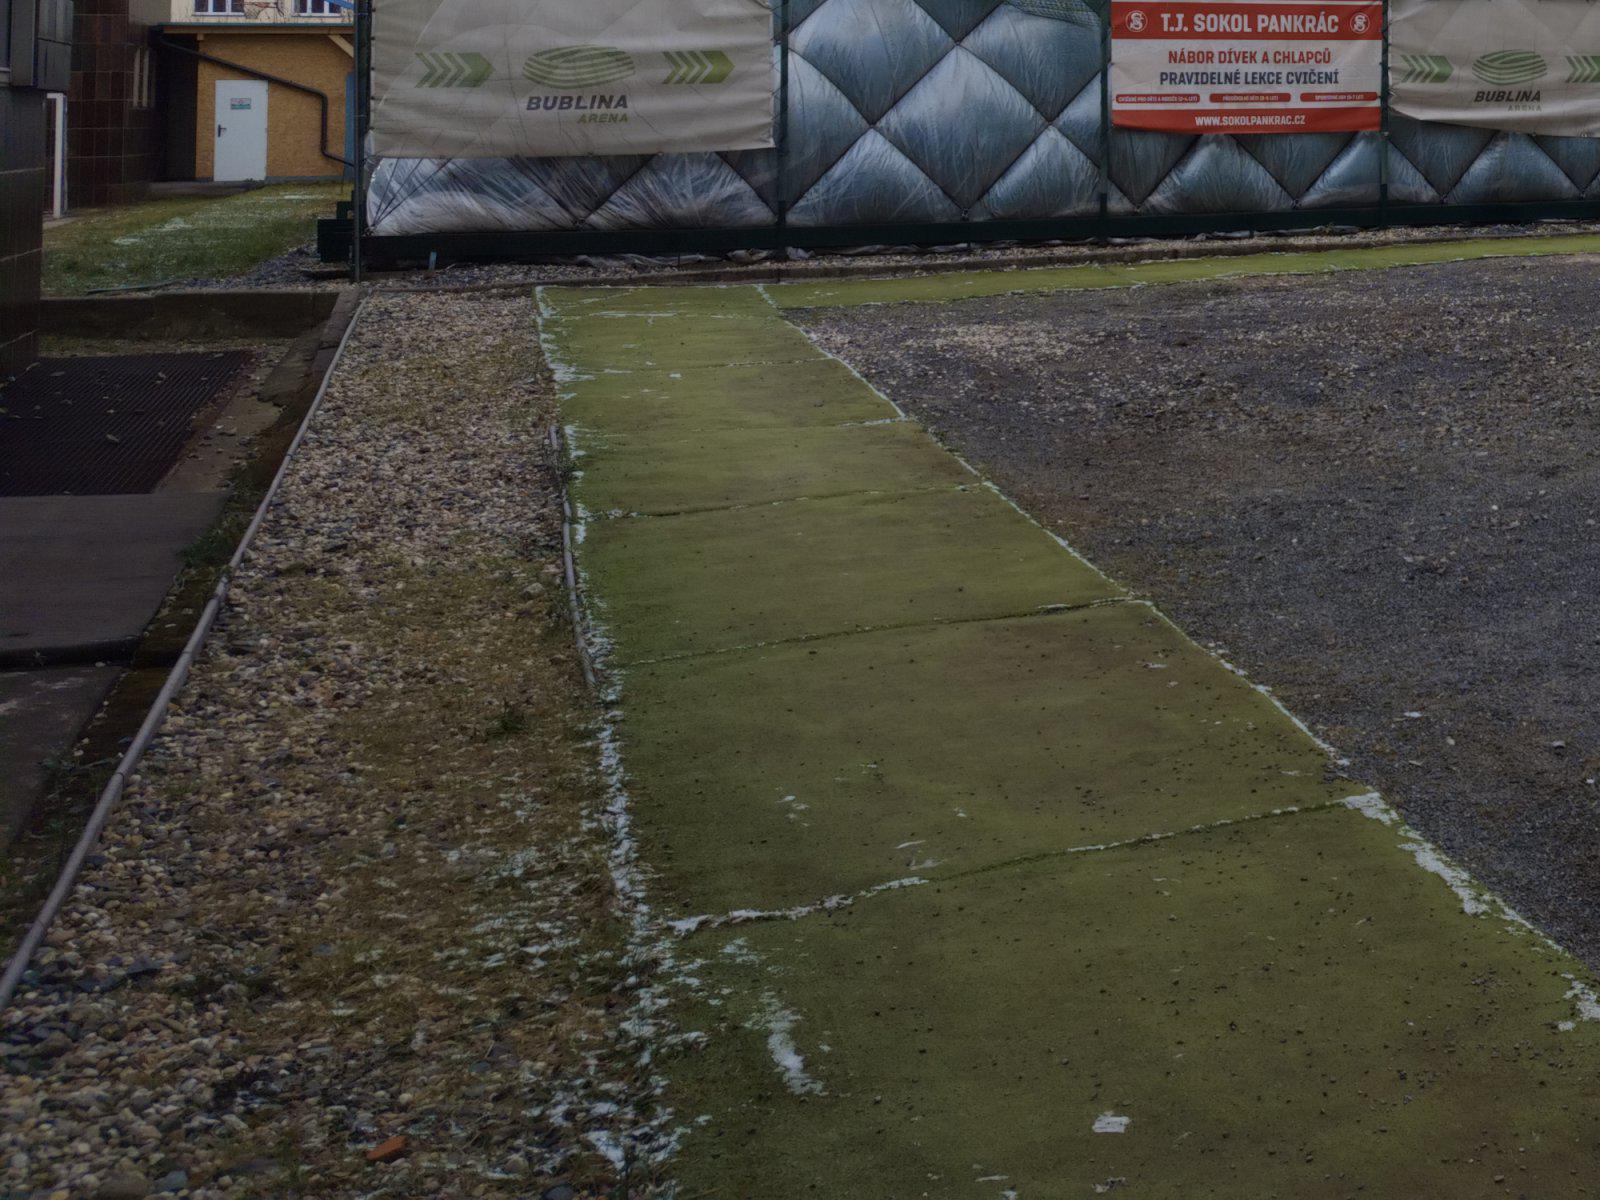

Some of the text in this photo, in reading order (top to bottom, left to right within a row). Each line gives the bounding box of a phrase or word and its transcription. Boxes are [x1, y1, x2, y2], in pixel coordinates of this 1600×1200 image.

[1161, 10, 1339, 33] T.J. SOKOL PANKRÁC
[1168, 47, 1331, 64] NÁBOR DÍVEK A CHLAPCŮ
[1160, 68, 1339, 85] PRAVIDELNÉ LEKCE CVIČENÍ
[526, 95, 629, 111] BUBLINA
[1474, 90, 1541, 102] BUBLINA
[577, 113, 629, 123] ARENA
[1195, 115, 1306, 126] WWW.SOKOLPANKRAC.CZ
